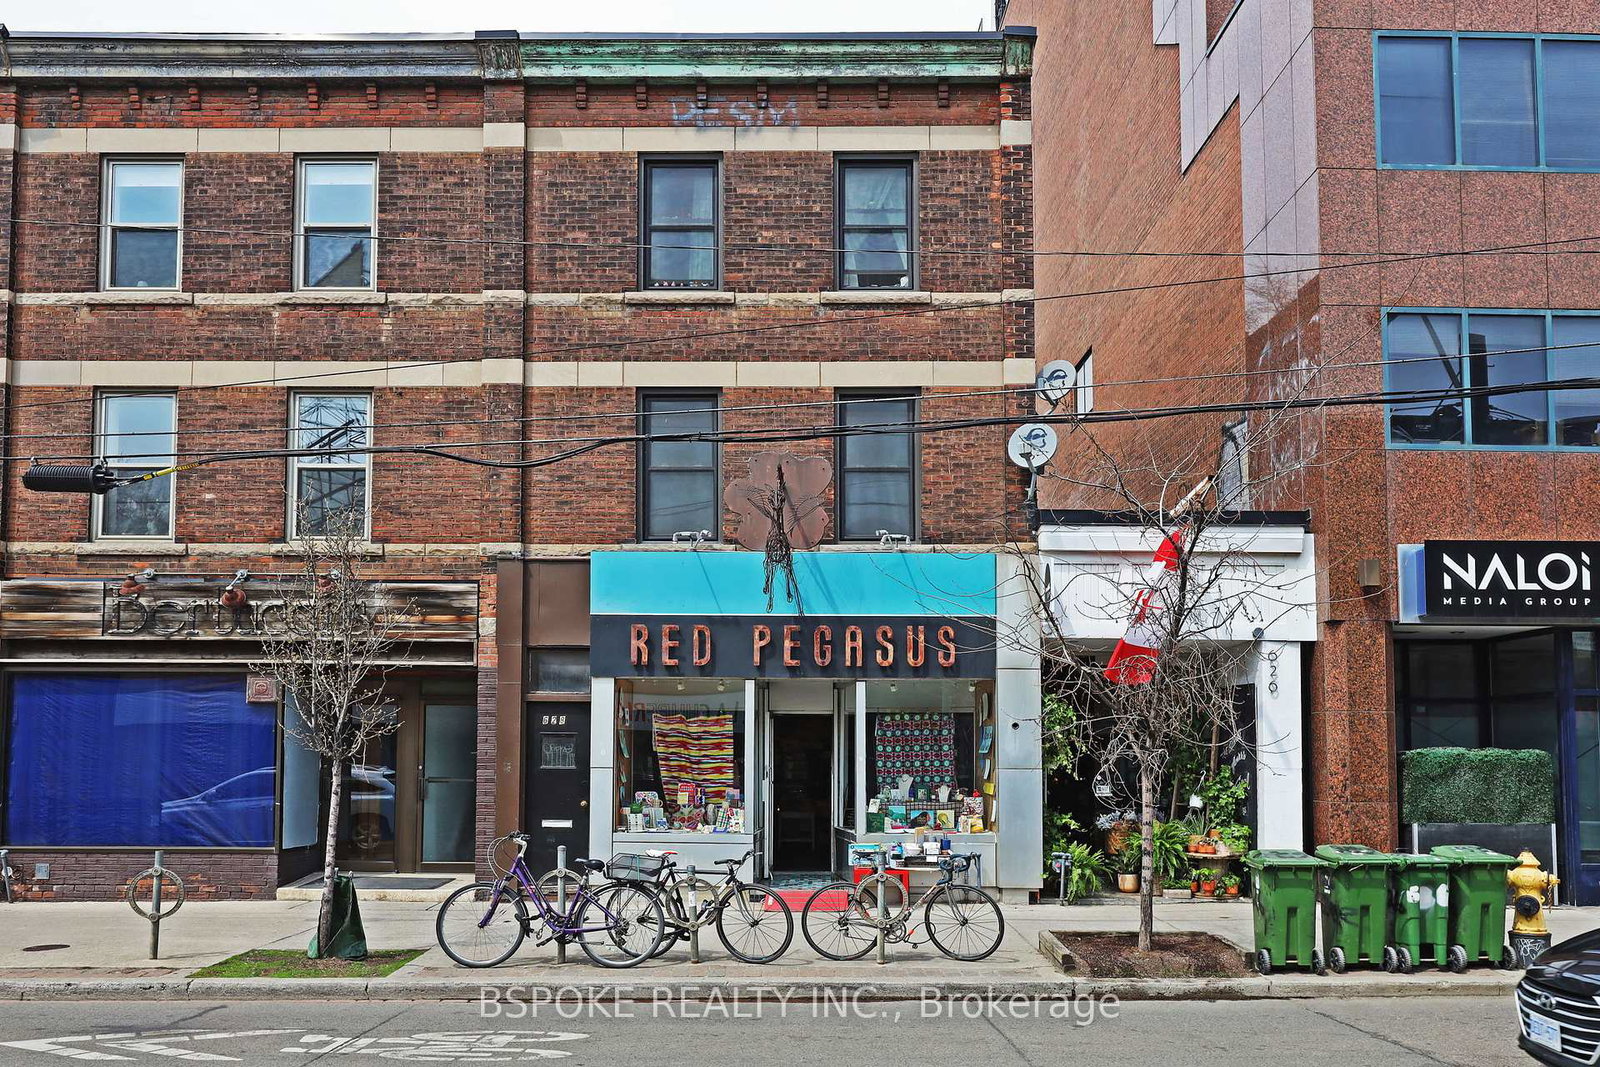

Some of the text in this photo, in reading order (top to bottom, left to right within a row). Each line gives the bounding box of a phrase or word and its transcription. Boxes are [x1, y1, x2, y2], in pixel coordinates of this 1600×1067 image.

[1443, 597, 1591, 606] MEDIA GROUP
[630, 623, 957, 667] RED PEGASUS
